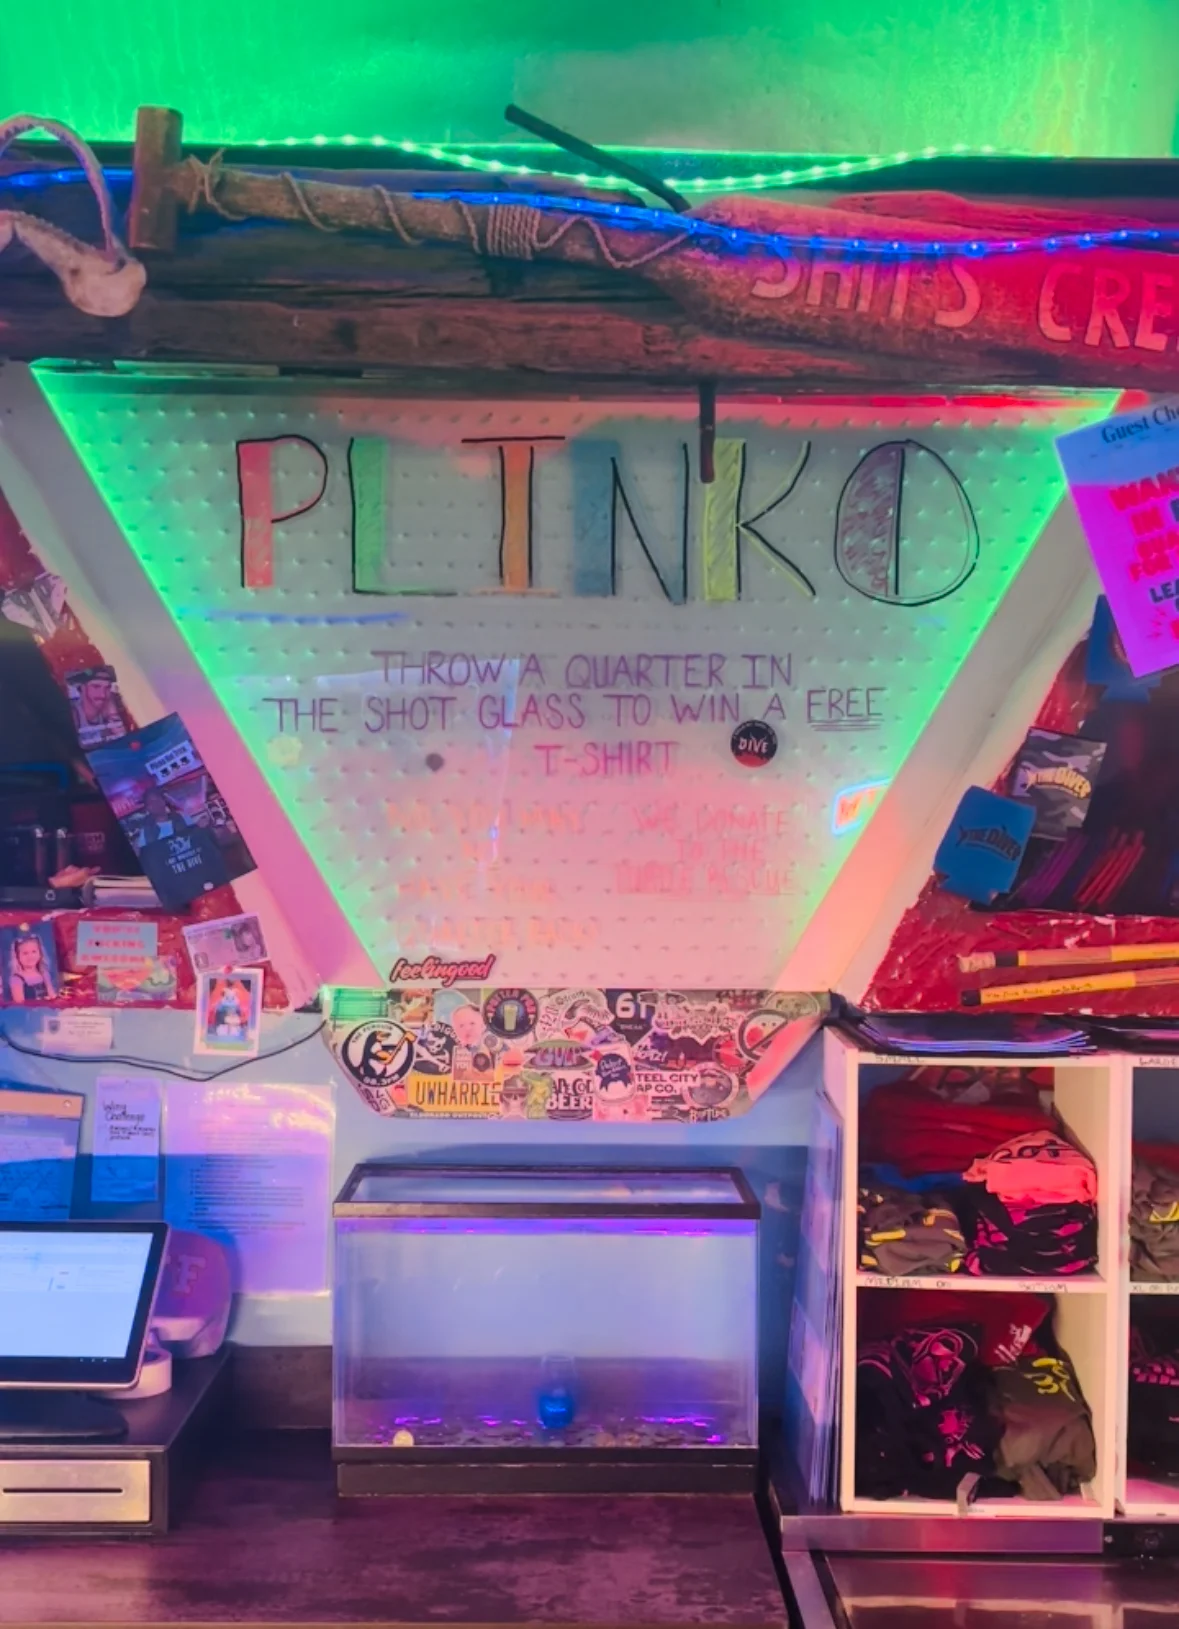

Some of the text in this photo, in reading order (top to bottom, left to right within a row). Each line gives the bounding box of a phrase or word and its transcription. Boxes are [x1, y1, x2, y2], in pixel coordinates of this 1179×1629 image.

[1101, 416, 1150, 445] Guest
[236, 434, 981, 607] PLINKO
[371, 650, 794, 690] THROW A QUARTER IN
[262, 687, 887, 733] THE SHOT GLASS TO WIN A FREE
[534, 740, 680, 778] T-SHIRT
[738, 732, 769, 754] DIVE
[636, 1073, 699, 1083] TEEL CITY
